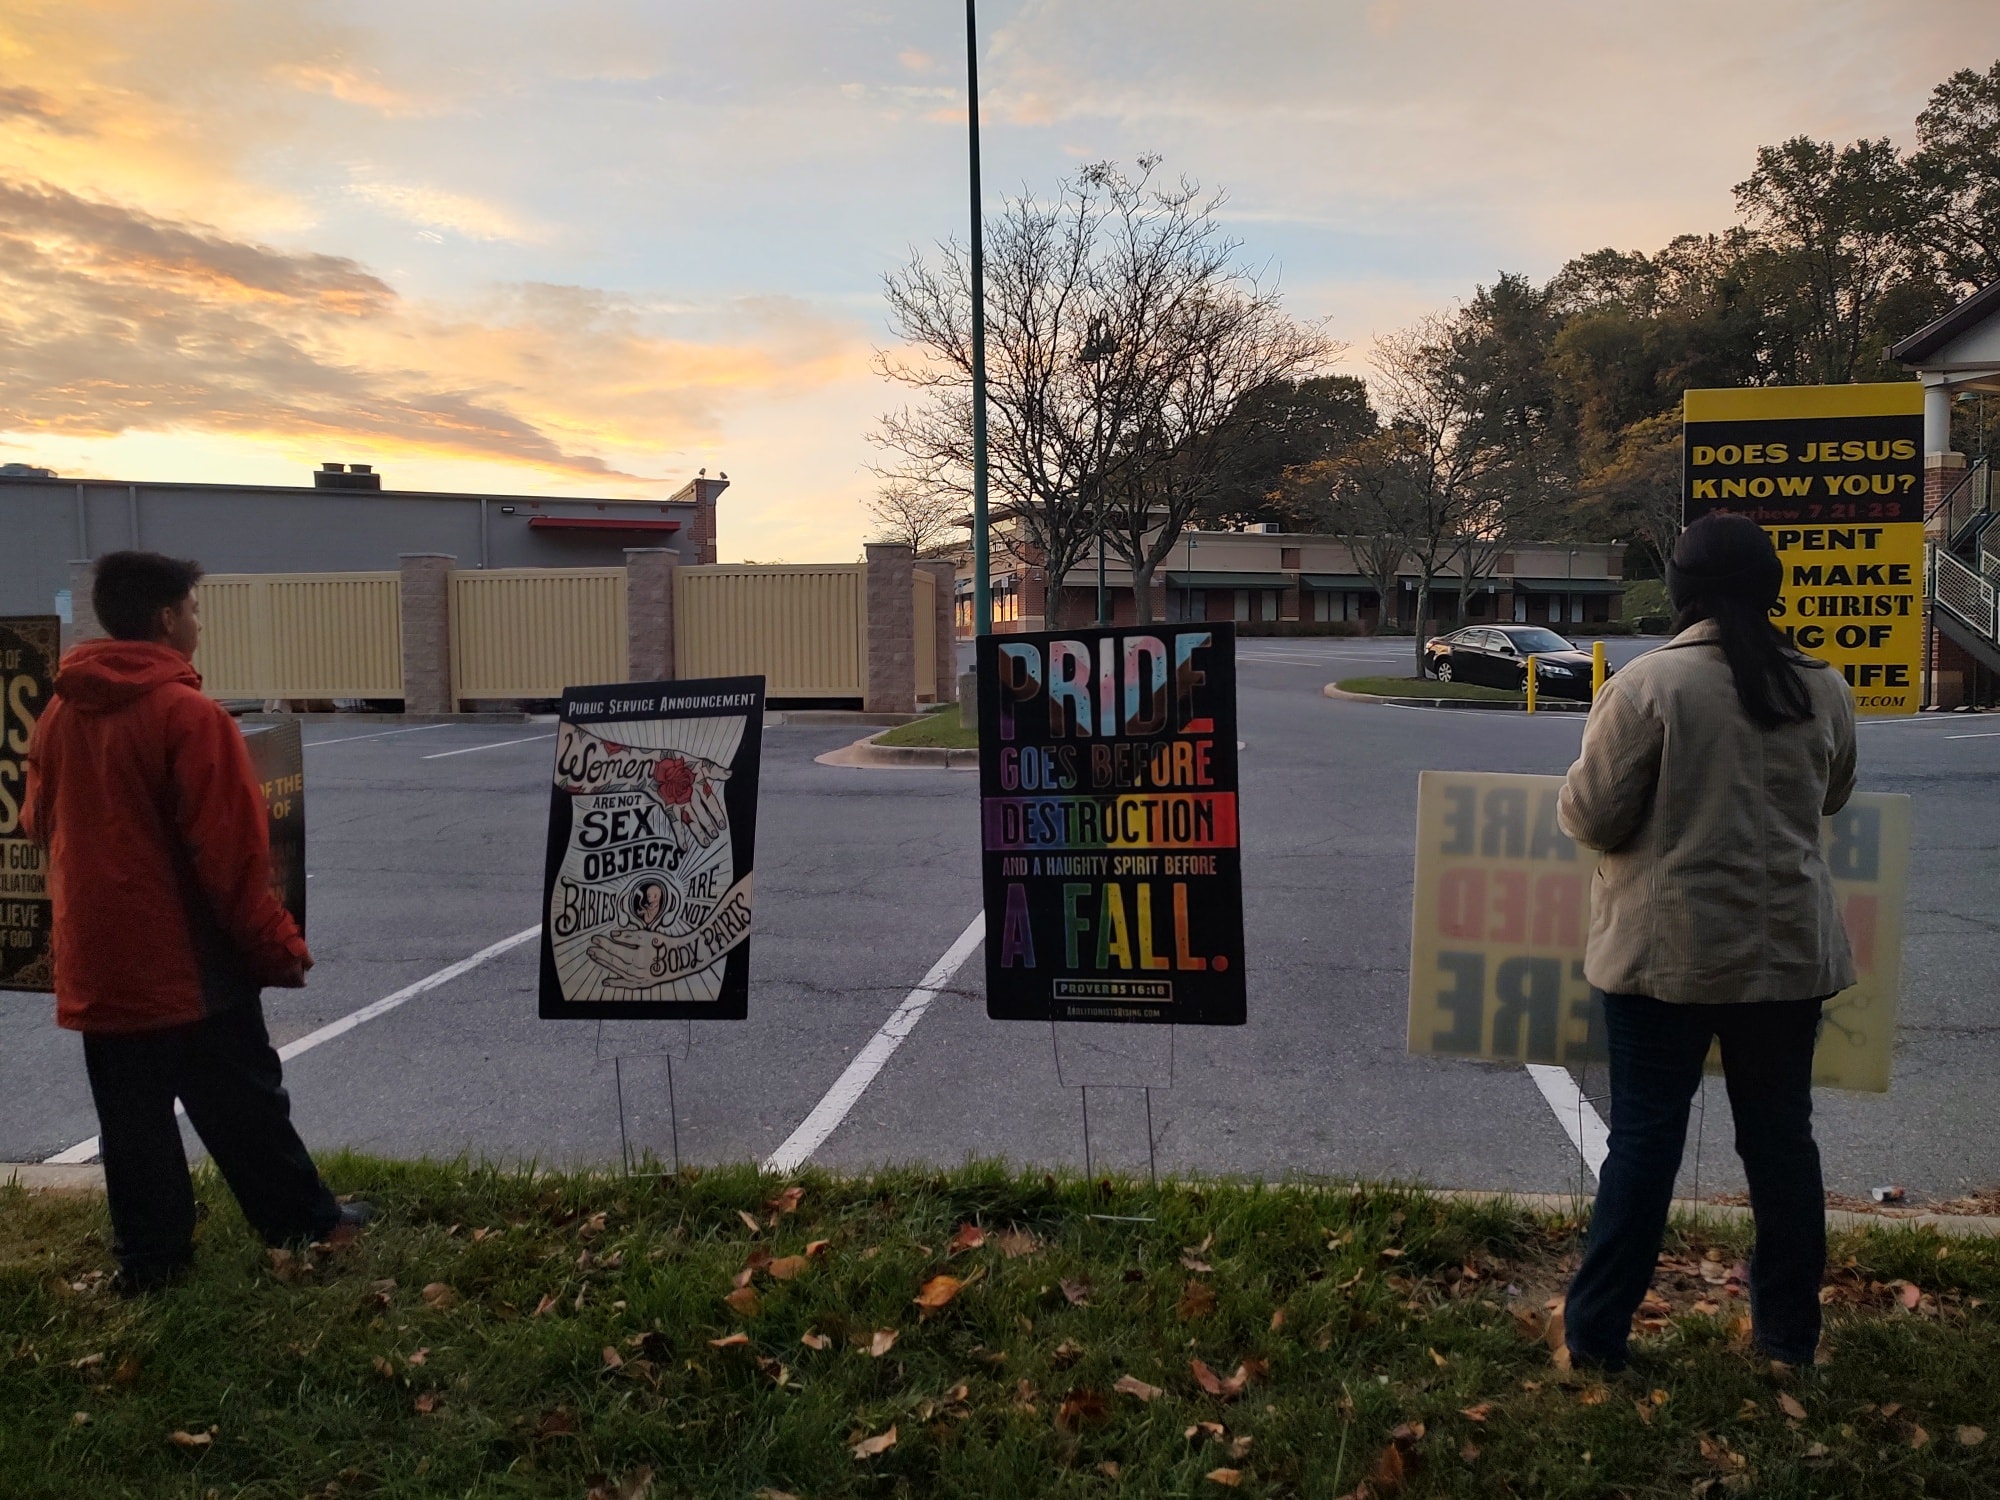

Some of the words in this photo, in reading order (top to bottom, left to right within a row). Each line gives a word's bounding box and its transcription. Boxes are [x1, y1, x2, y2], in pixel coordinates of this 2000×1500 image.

[1692, 442, 1789, 466] DOES
[1797, 439, 1917, 463] JESUS
[1692, 476, 1813, 499] KNOW
[1823, 474, 1917, 496] YOU?
[1765, 528, 1883, 551] PENT
[1792, 564, 1912, 587] MAKE
[1797, 595, 1914, 617] CHRIST
[1835, 625, 1893, 648] OF
[998, 632, 1215, 740] PRIDE
[1843, 664, 1910, 687] IFE
[568, 700, 604, 717] PUBLIC
[609, 698, 655, 715] SERVICE
[660, 693, 757, 712] ANNOUNCEMENT
[1855, 696, 1906, 707] T.COM
[558, 733, 656, 784] Women
[1001, 745, 1078, 790] GOES
[1091, 740, 1215, 788] BEFORE
[275, 773, 302, 796] THE
[273, 799, 291, 819] OF
[592, 796, 616, 809] ARE
[616, 795, 642, 807] NOT
[578, 805, 658, 848] SEX
[1001, 798, 1214, 845] DESTRUCTION
[10, 843, 40, 870] GOD
[583, 847, 688, 881] OBJECTS
[1002, 856, 1028, 876] AND
[1033, 856, 1042, 875] A
[1046, 855, 1108, 876] HAUGHTY
[1114, 855, 1159, 876] SPIRIT
[1164, 855, 1217, 876] BEFORE
[555, 876, 617, 937] BABIES
[687, 864, 720, 899] ARE
[681, 902, 711, 927] NOT
[1001, 882, 1036, 968] A
[1063, 882, 1229, 972] FALL.
[649, 937, 704, 977] BODY
[702, 892, 751, 957] PARTS
[1060, 983, 1127, 995] PROVERBS
[1131, 984, 1165, 995] 16:18
